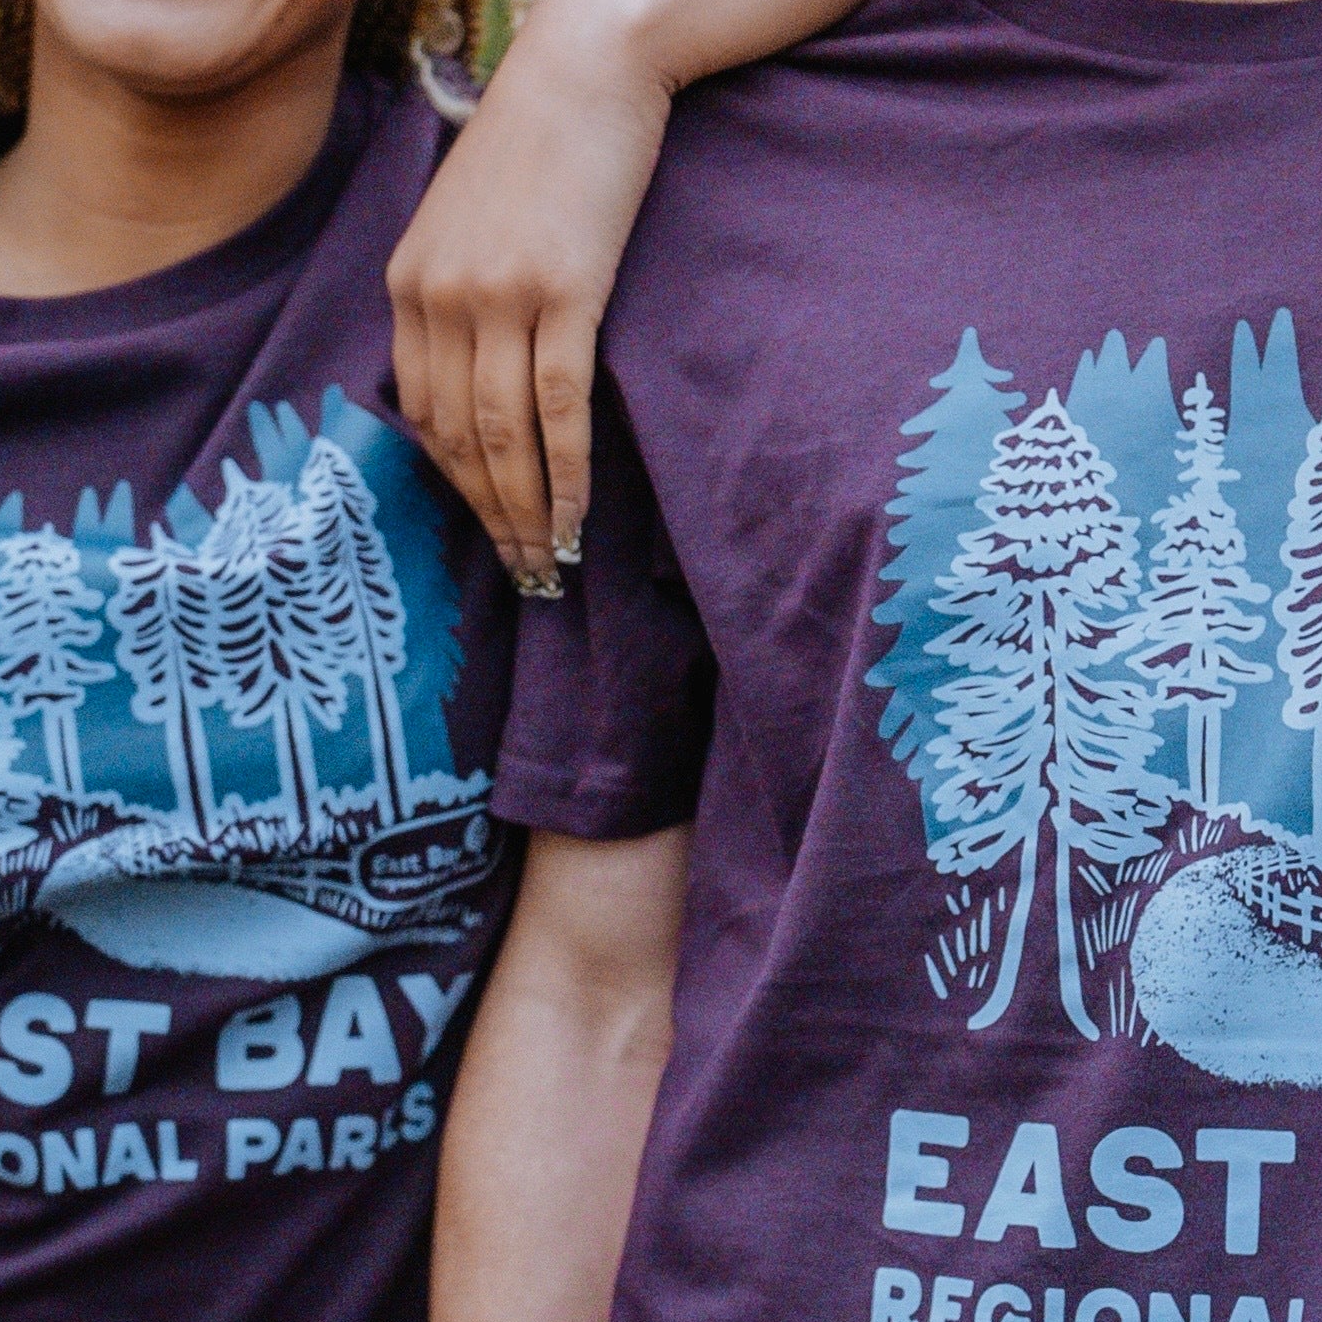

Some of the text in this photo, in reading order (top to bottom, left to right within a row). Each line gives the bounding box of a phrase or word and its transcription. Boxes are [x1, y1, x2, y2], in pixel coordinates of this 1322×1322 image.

[215, 970, 476, 1092] BAY
[225, 1080, 438, 1182] PARS
[882, 1108, 1296, 1255] EAST
